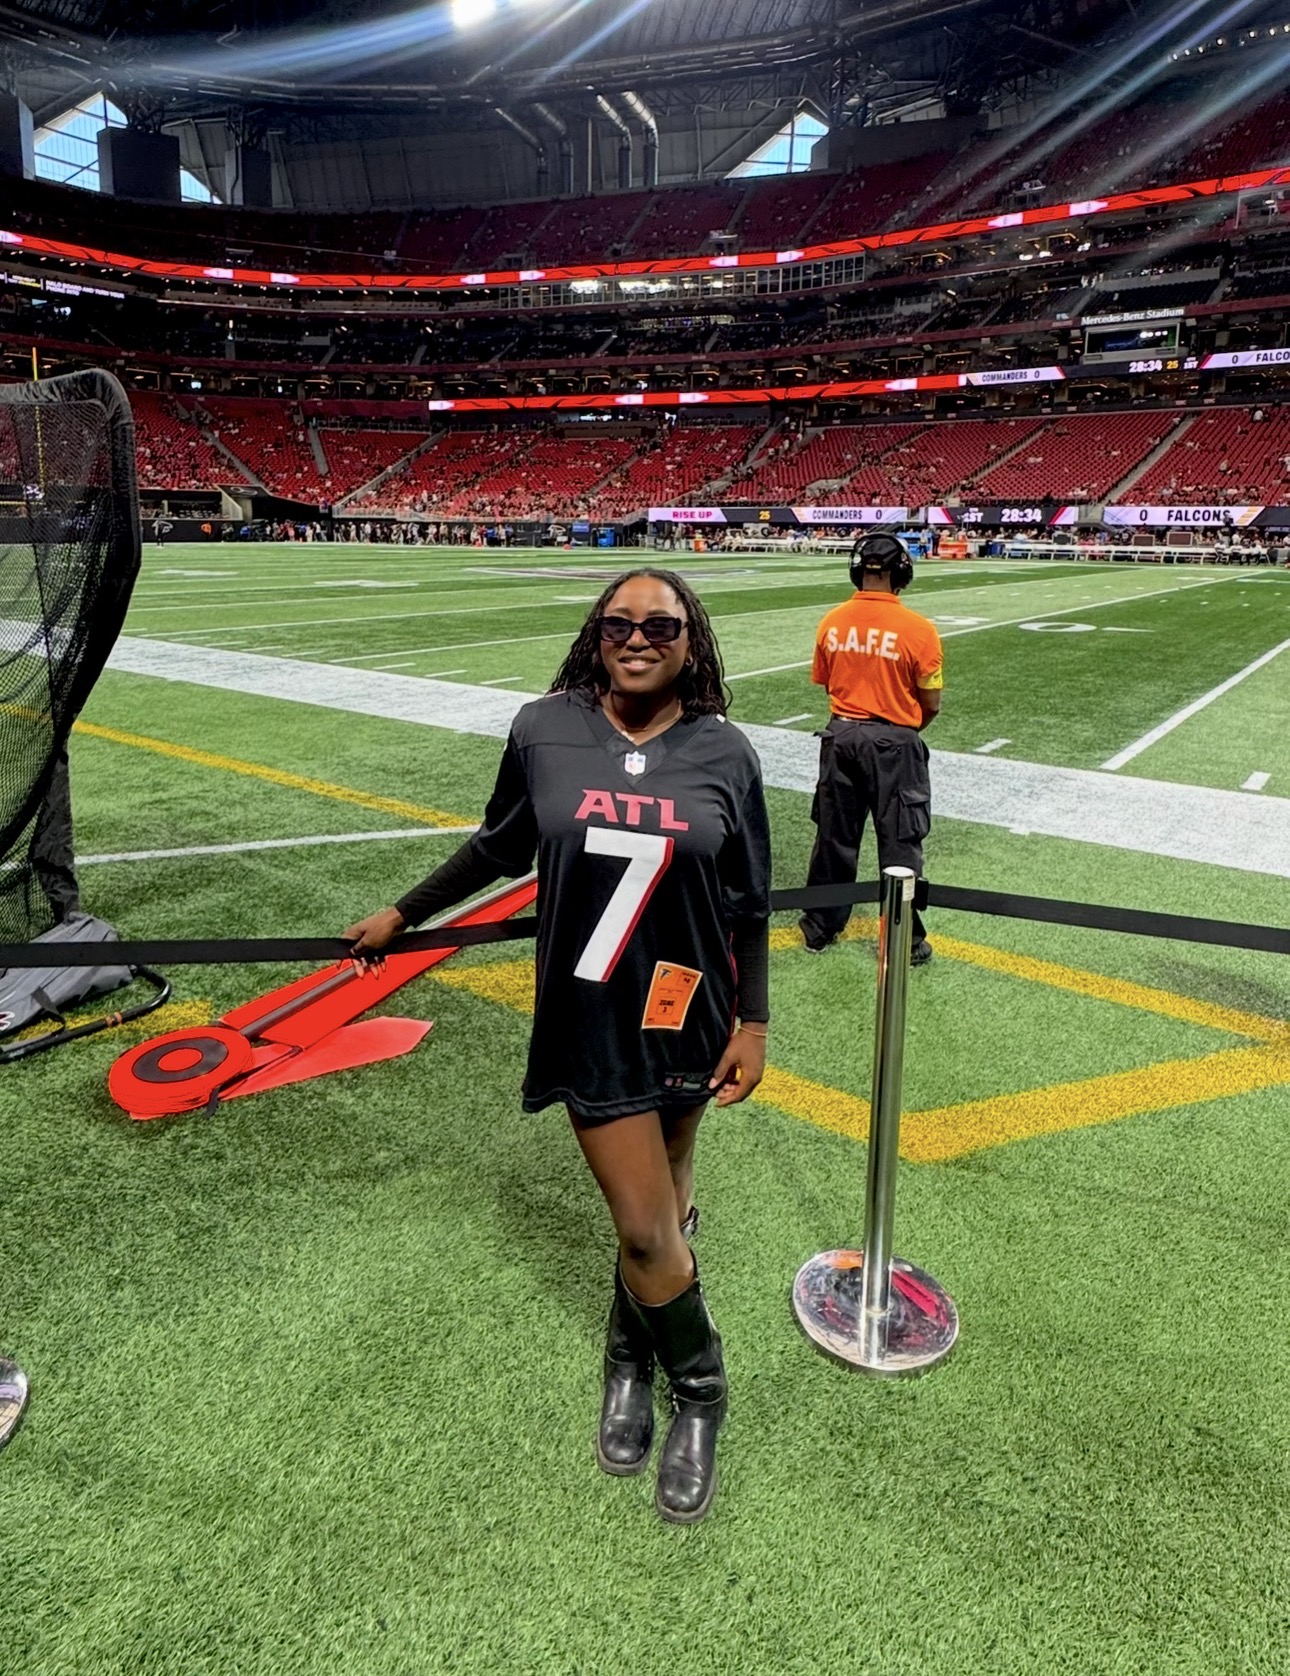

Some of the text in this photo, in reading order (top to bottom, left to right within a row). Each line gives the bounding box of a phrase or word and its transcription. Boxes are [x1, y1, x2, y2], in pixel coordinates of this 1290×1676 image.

[1081, 308, 1185, 326] Mercedes-Benz Stadium
[1129, 359, 1163, 373] 28:34
[1166, 360, 1179, 370] 25
[1232, 355, 1239, 364] 0
[981, 370, 1040, 383] COMMANDERS 0
[672, 511, 713, 519] RISE UP
[759, 511, 770, 520] 25
[812, 509, 882, 520] COMMANDERS 0
[1001, 508, 1042, 523] 28:34
[1139, 509, 1148, 521] 0
[827, 626, 900, 661] S.A.F.E.
[574, 789, 690, 832] ATL
[573, 826, 675, 983] 7
